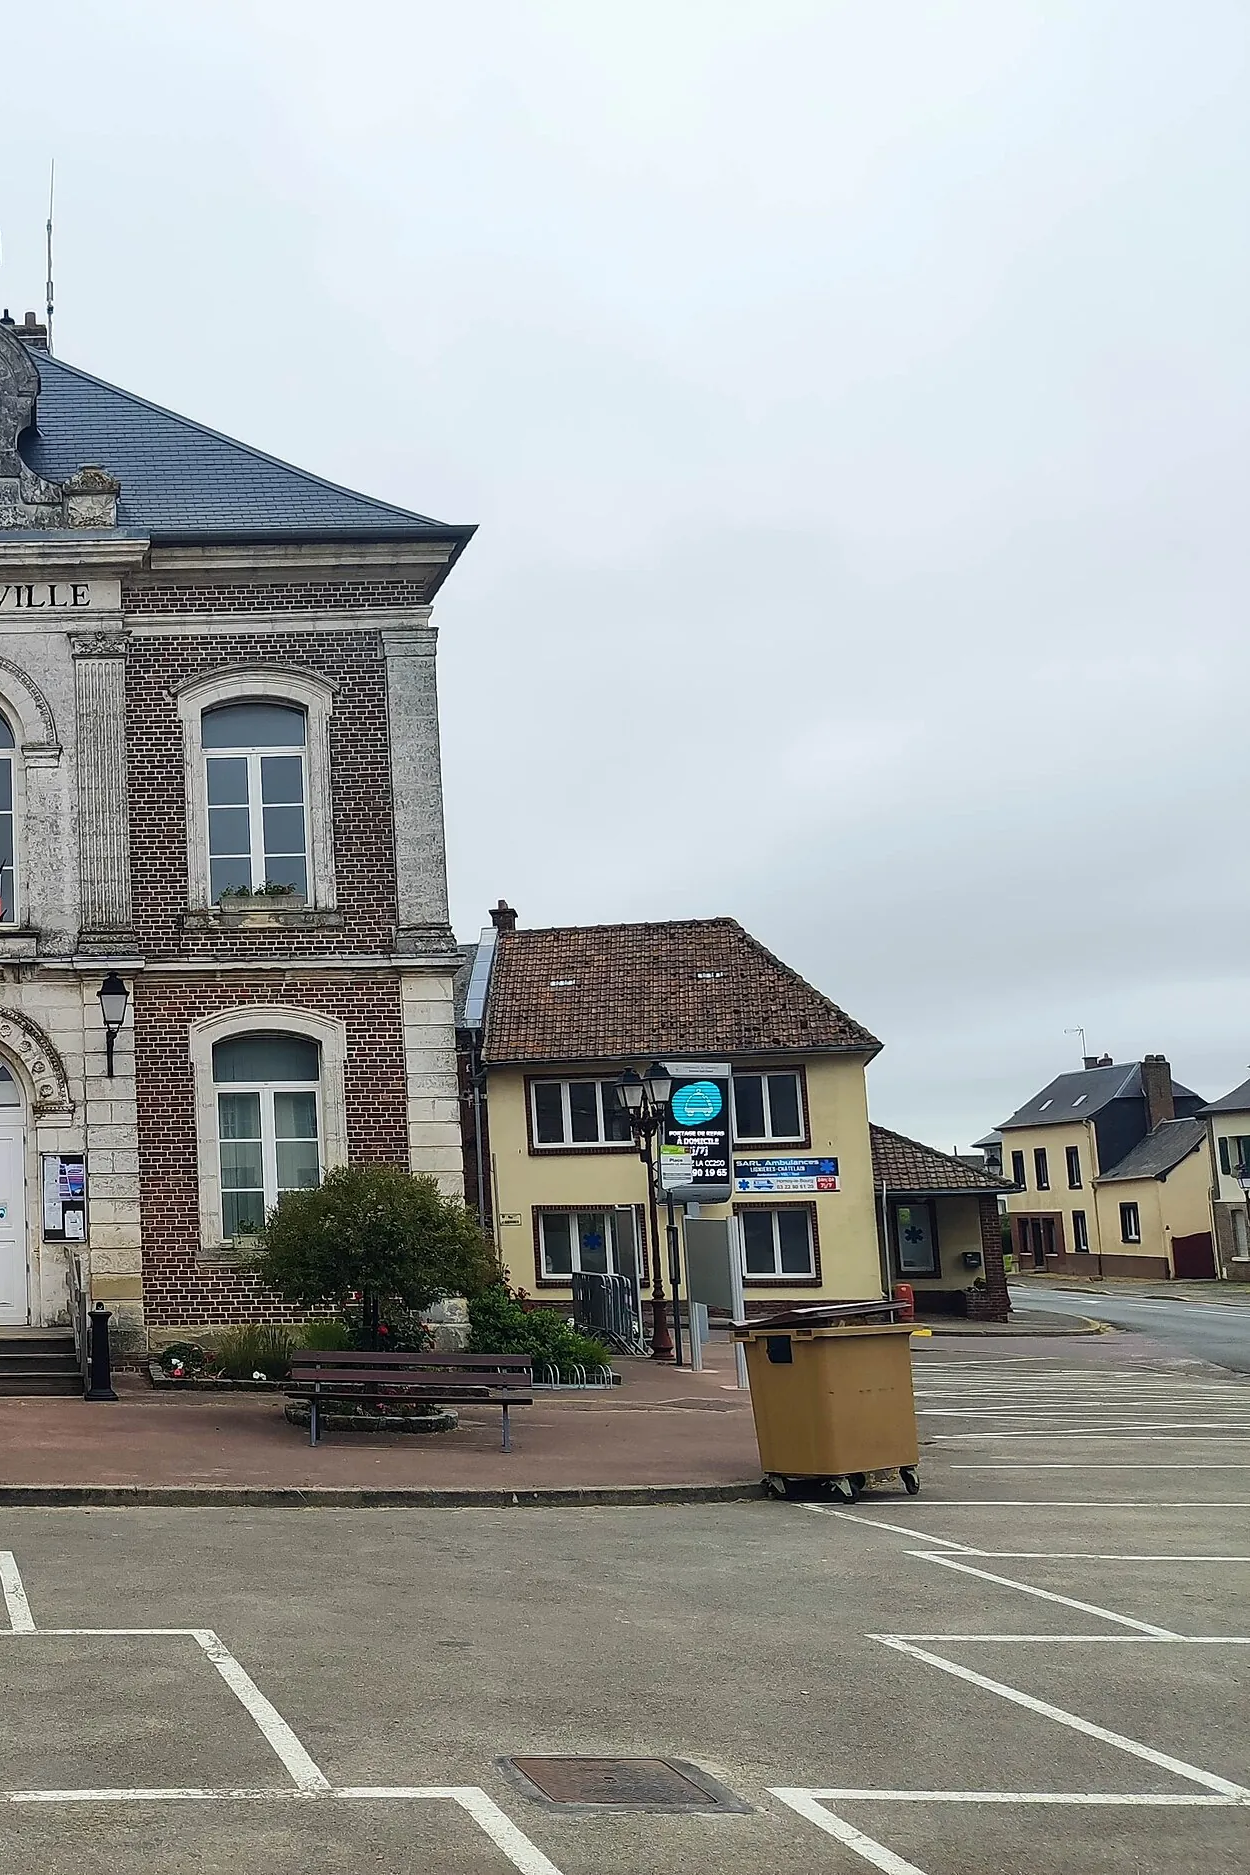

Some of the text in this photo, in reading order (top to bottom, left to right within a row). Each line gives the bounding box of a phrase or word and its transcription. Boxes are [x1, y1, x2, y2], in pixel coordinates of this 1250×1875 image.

[683, 1137, 720, 1145] DOMICILE
[695, 1159, 704, 1167] LA
[764, 1159, 820, 1167] Ambulances
[704, 1168, 716, 1177] 19
[716, 1168, 728, 1177] 65
